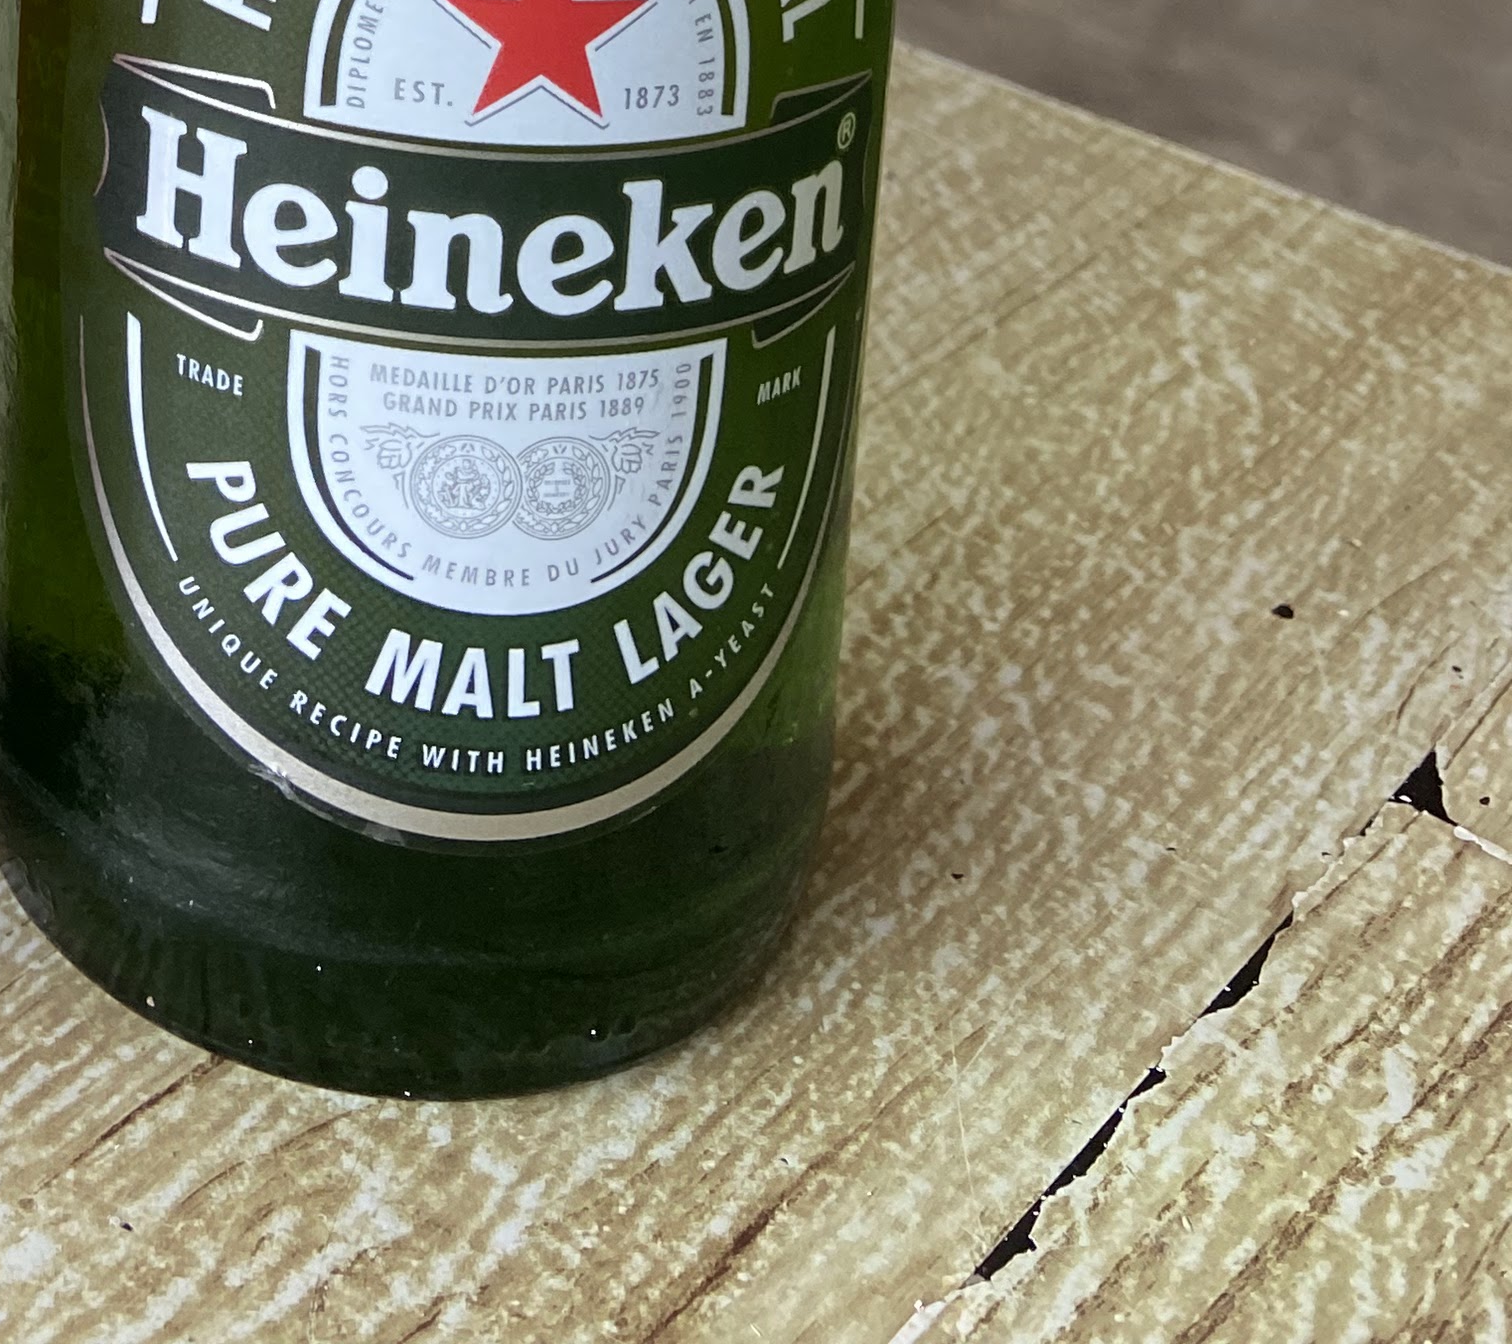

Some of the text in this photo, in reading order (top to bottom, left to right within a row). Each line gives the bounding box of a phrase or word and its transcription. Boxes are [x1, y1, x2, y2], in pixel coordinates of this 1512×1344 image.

[694, 12, 714, 44] EN
[346, 0, 385, 110] DIPLOME
[393, 77, 681, 110] EST. 1873
[696, 56, 716, 117] 1883
[175, 352, 244, 397] TRADE
[369, 363, 660, 396] MEDAILLE D'OR PARIS 1875
[756, 364, 802, 406] MARK
[382, 391, 645, 422] GRAND PRIX PARIS 1889
[328, 355, 692, 588] HORS CONCOURS MEMBRE DU JURY PARIS 1900
[185, 457, 785, 719] PURE MALT LAGER
[178, 575, 776, 774] UNIQUE RECIPE WITH HEINEKEN A-YEAST
